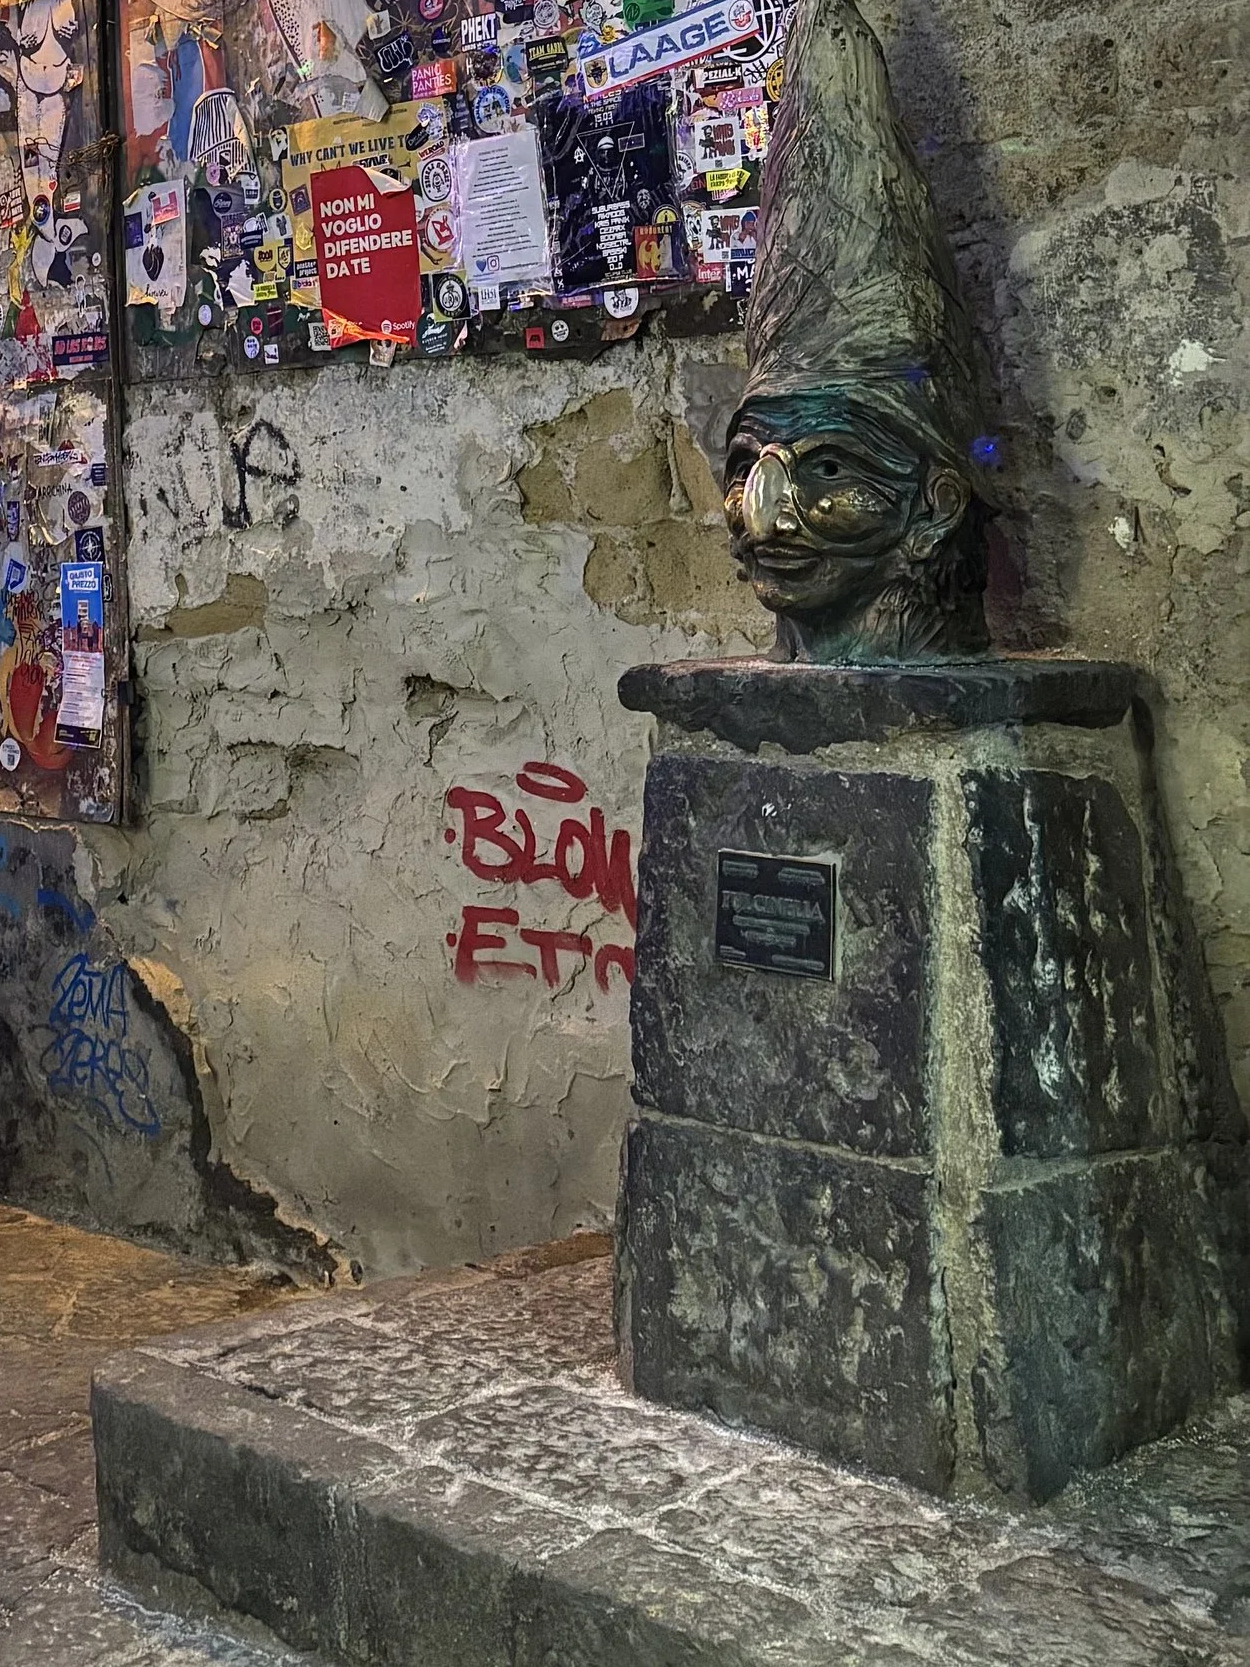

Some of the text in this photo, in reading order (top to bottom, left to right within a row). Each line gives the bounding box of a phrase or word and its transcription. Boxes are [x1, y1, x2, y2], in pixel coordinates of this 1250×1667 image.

[461, 12, 497, 45] PHEKT
[608, 10, 731, 80] LAAGE
[411, 62, 442, 82] PANIC
[699, 66, 742, 82] PEZIAL-K
[412, 73, 452, 94] PANTIES
[291, 151, 312, 167] WHY
[317, 143, 347, 162] CAN'T
[348, 141, 366, 155] WE
[368, 136, 394, 152] LIVE
[319, 193, 376, 218] NON MI
[321, 213, 383, 238] VOGLIO
[323, 229, 413, 259] DIFENDERE
[326, 257, 372, 280] DA TE
[697, 267, 722, 281] Inter
[392, 319, 417, 331] Spotify
[69, 569, 94, 580] GIUSTO
[71, 579, 98, 590] PREZZO
